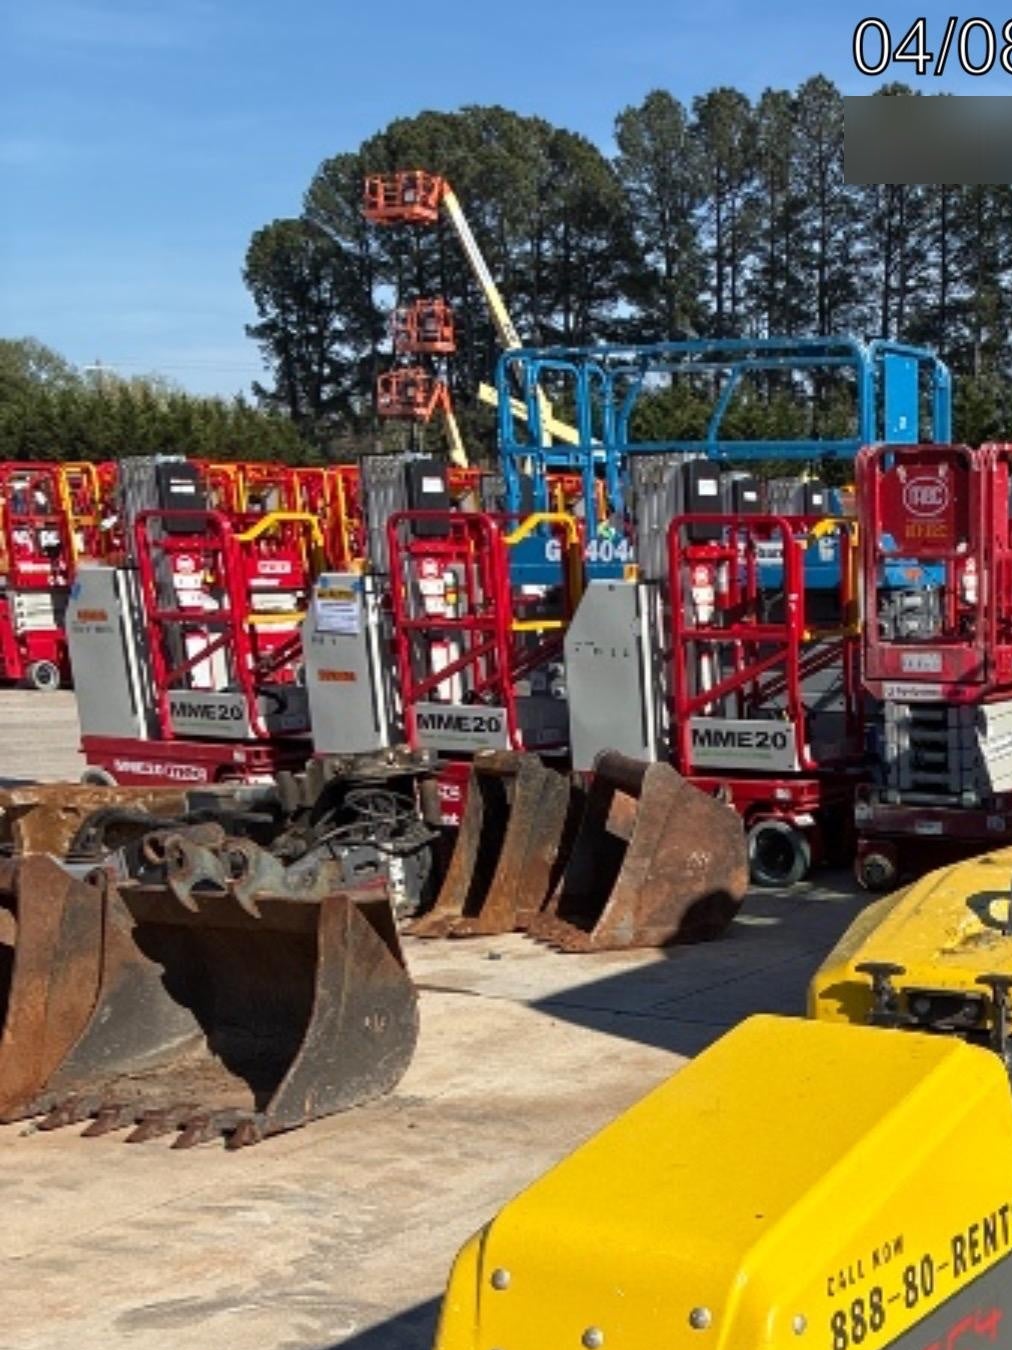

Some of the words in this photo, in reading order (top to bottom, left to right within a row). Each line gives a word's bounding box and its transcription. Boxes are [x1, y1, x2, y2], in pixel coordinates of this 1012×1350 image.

[169, 701, 244, 721] MME20
[416, 713, 500, 733] MME20
[692, 728, 787, 750] MME20
[827, 1259, 865, 1297] CALL
[871, 1233, 904, 1270] NOW
